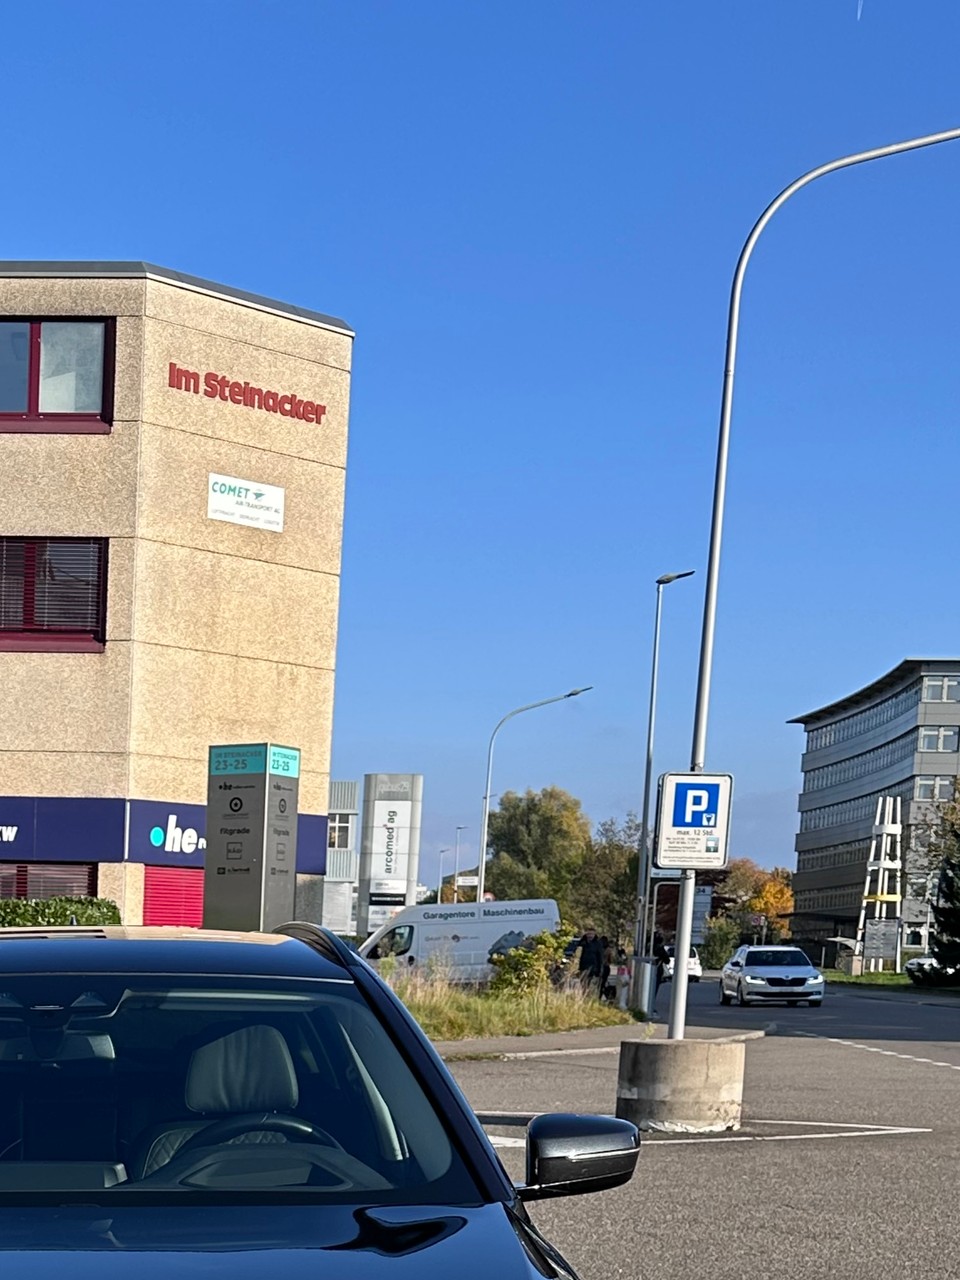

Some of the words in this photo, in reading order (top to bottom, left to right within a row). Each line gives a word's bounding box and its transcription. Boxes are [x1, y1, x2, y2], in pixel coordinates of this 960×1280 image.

[168, 362, 199, 394] Im
[204, 371, 327, 425] Steinacker
[211, 481, 251, 499] COMET
[215, 759, 248, 771] 23-25
[388, 810, 398, 824] ag
[384, 826, 394, 874] arcomed
[422, 911, 476, 920] Garagentore
[483, 908, 544, 917] Maschinenbau
